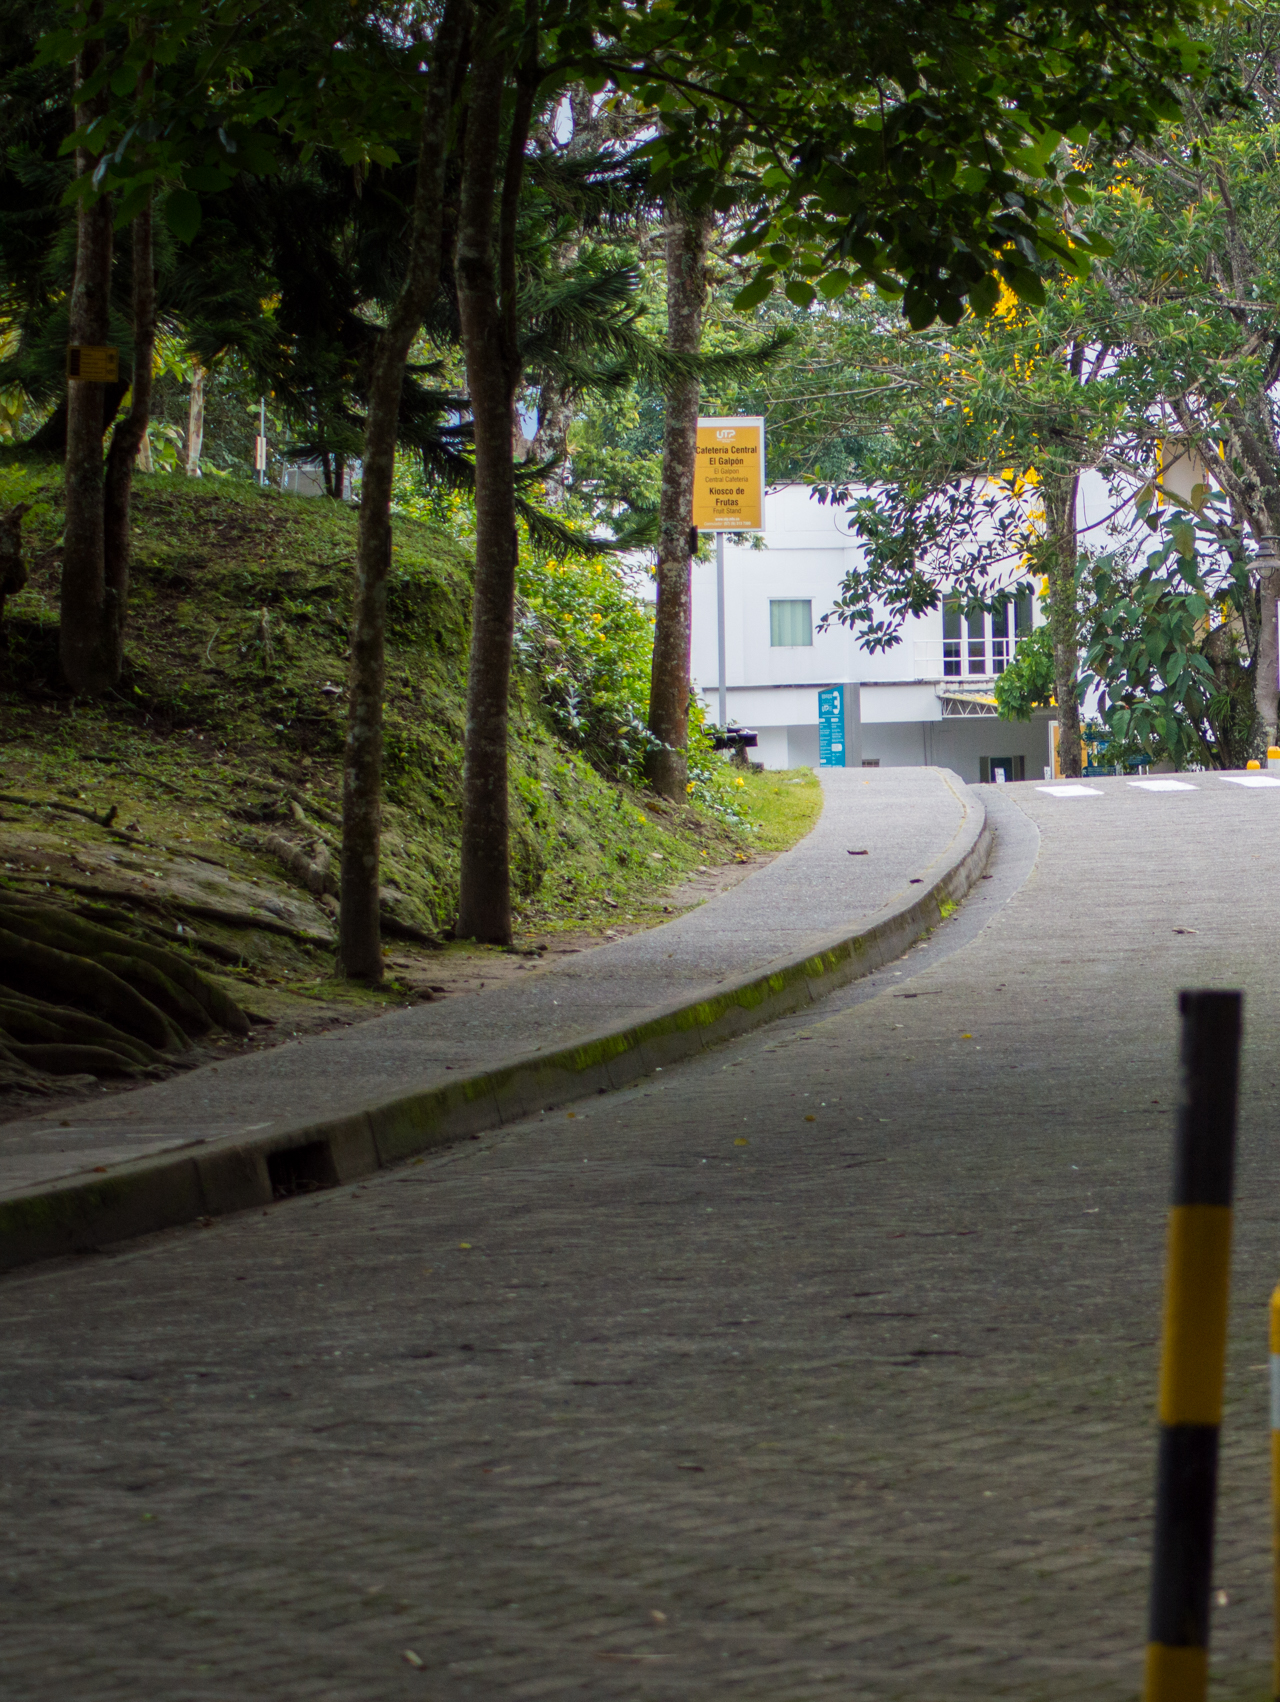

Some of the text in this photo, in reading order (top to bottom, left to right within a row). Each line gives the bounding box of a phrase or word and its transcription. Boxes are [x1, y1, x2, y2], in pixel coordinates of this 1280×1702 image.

[717, 430, 736, 439] UTP
[731, 446, 757, 454] Central
[709, 457, 744, 467] El Galpón
[709, 487, 745, 495] Kiosco de
[716, 498, 739, 506] Frutas
